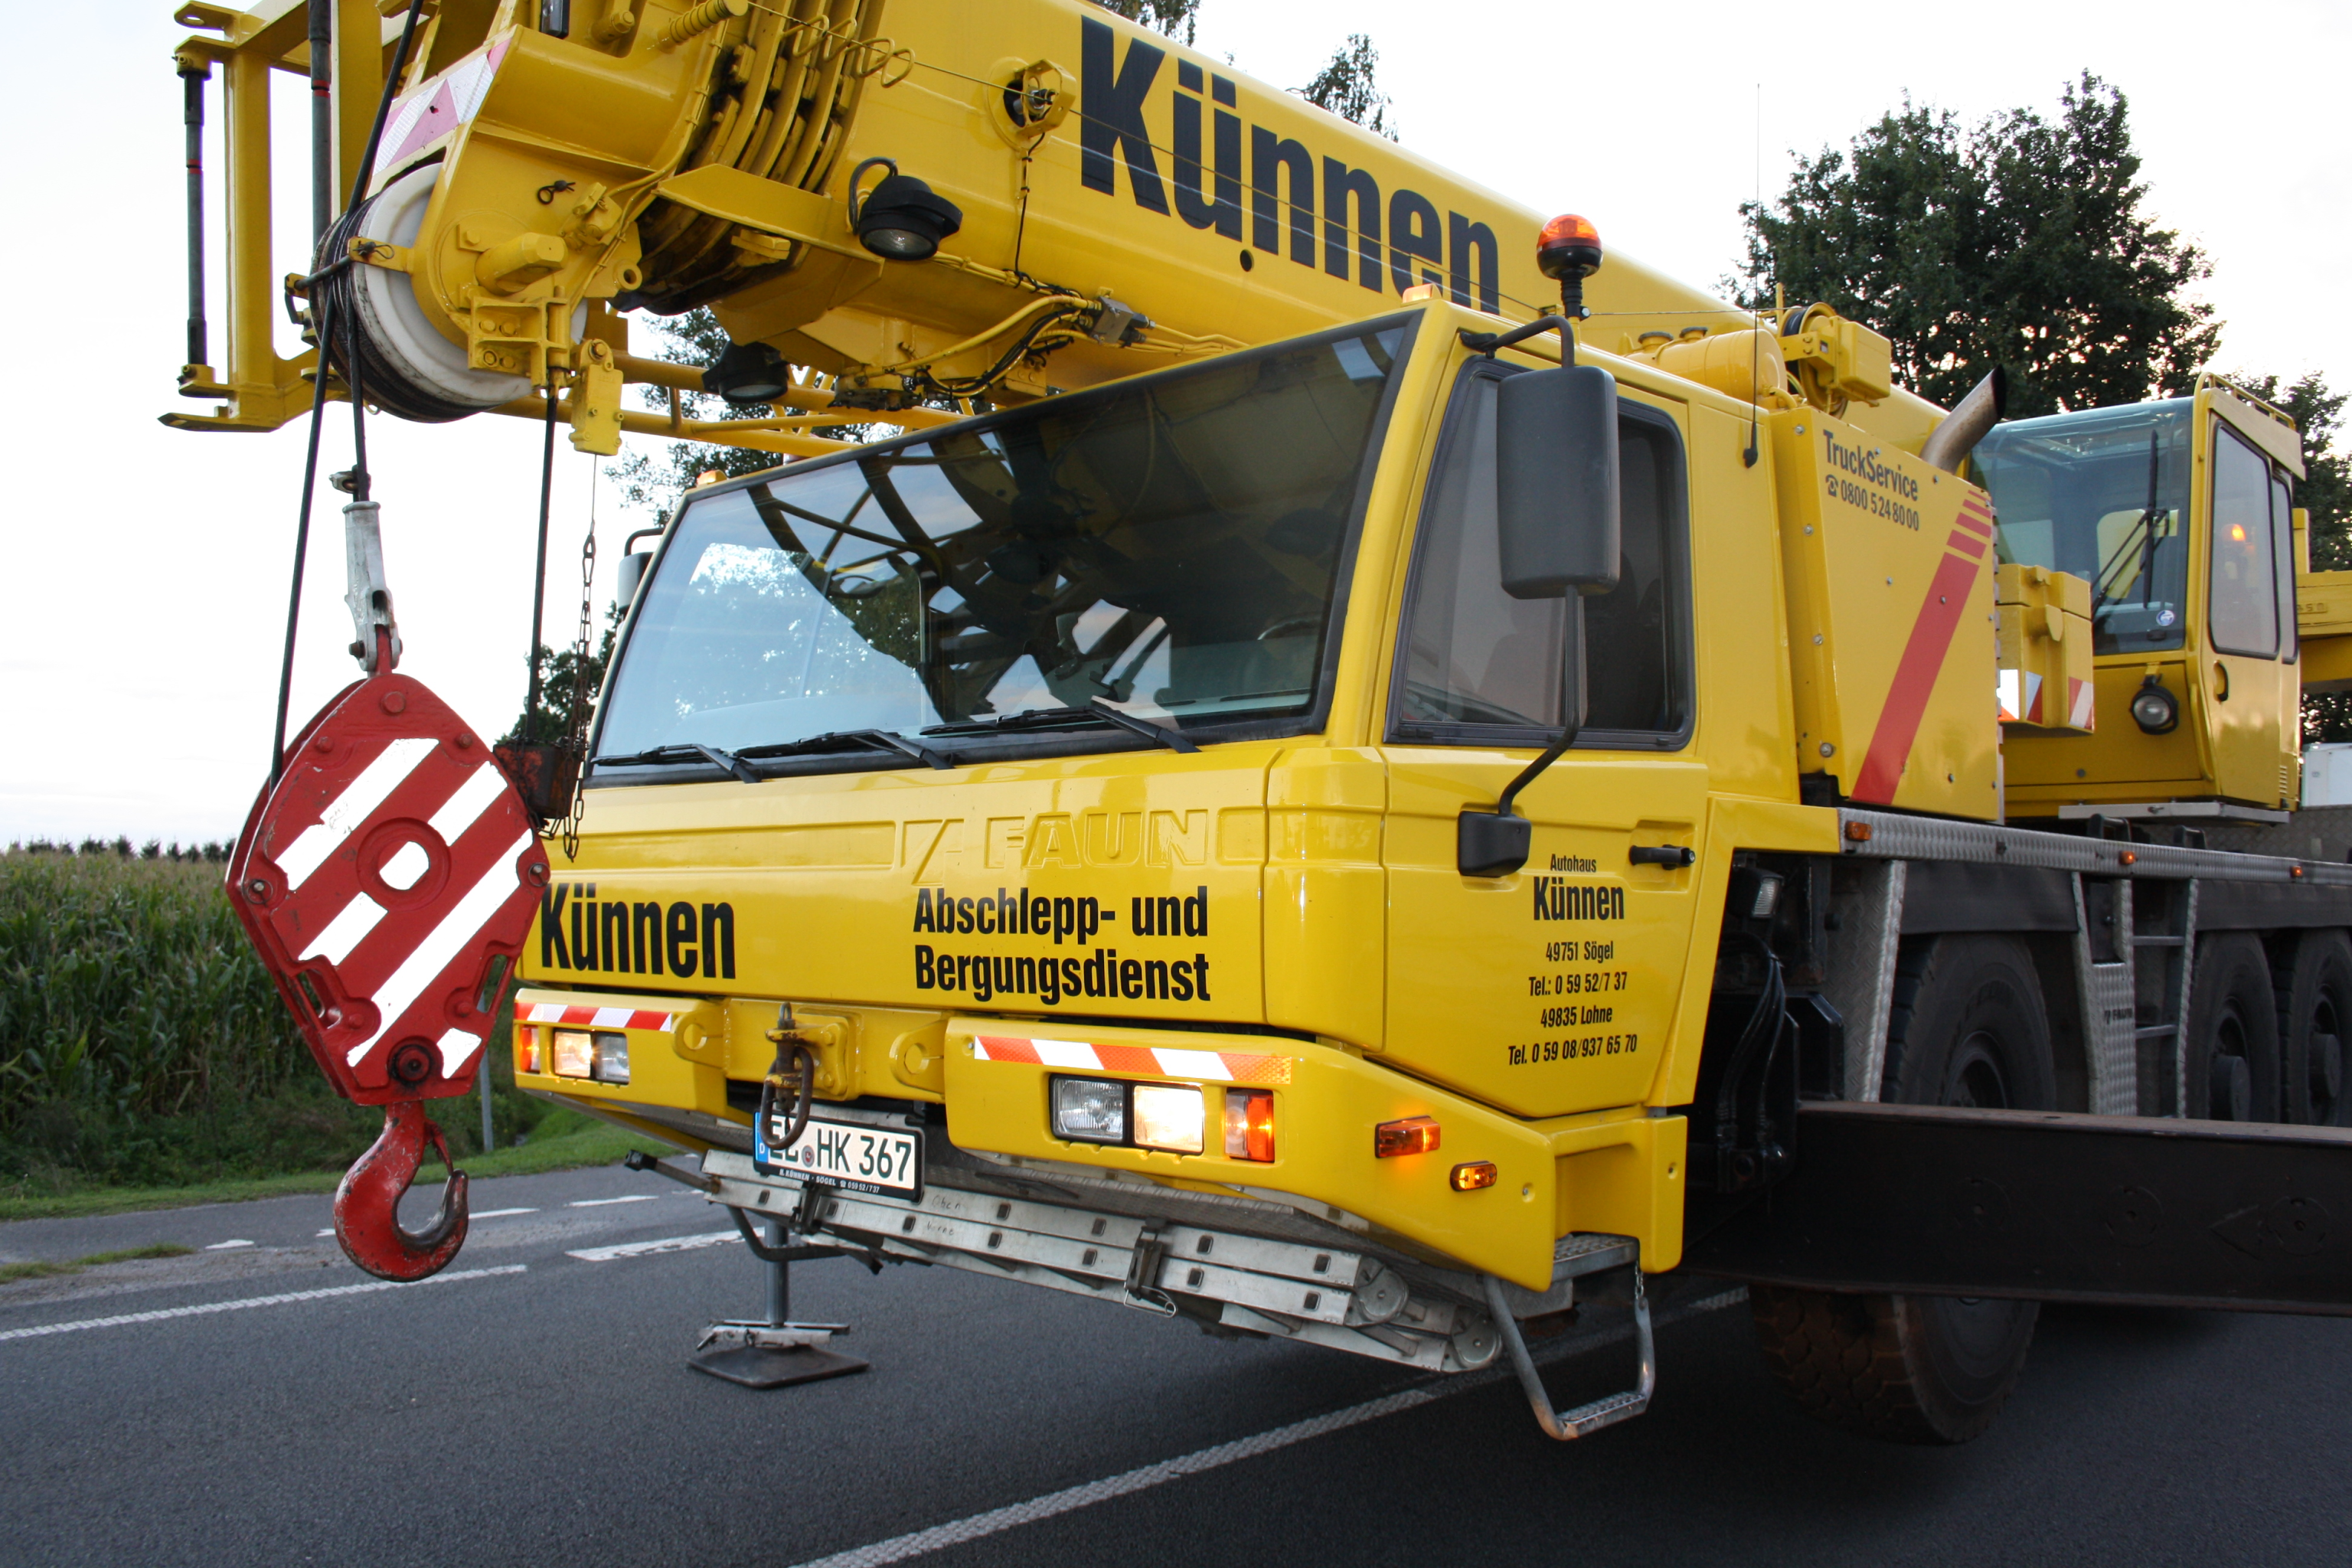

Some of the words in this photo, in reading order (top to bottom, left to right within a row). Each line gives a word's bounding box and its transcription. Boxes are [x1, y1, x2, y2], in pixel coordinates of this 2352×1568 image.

[1081, 15, 1500, 315] Künnen
[1823, 429, 1918, 501] TruckService
[1841, 479, 1867, 510] 0800
[985, 808, 1208, 870] FAUN
[1550, 854, 1596, 872] Autohaus
[913, 887, 1116, 945] Abschlepp-
[1132, 886, 1207, 936] und
[1534, 876, 1625, 920] Künnen
[541, 883, 736, 979] Künnen
[1546, 942, 1578, 962] 49751
[1584, 940, 1613, 963] Sögel
[915, 945, 1211, 1005] Bergungsdienst
[1528, 976, 1551, 996] Tel.:
[1555, 975, 1563, 995] 0
[1566, 974, 1580, 994] 59
[1614, 972, 1627, 991] 37
[1540, 1006, 1576, 1028] 49835
[1580, 1004, 1612, 1024] Lohne
[1508, 1044, 1527, 1065] Tel.
[1532, 1043, 1540, 1063] 0
[1544, 1041, 1558, 1061] 59
[1562, 1037, 1603, 1059] 08/937
[1606, 1035, 1621, 1054] 65
[1625, 1034, 1637, 1053] 70
[817, 1128, 851, 1173] HK
[859, 1135, 912, 1181] 367
[815, 1175, 836, 1186] SÖGEL
